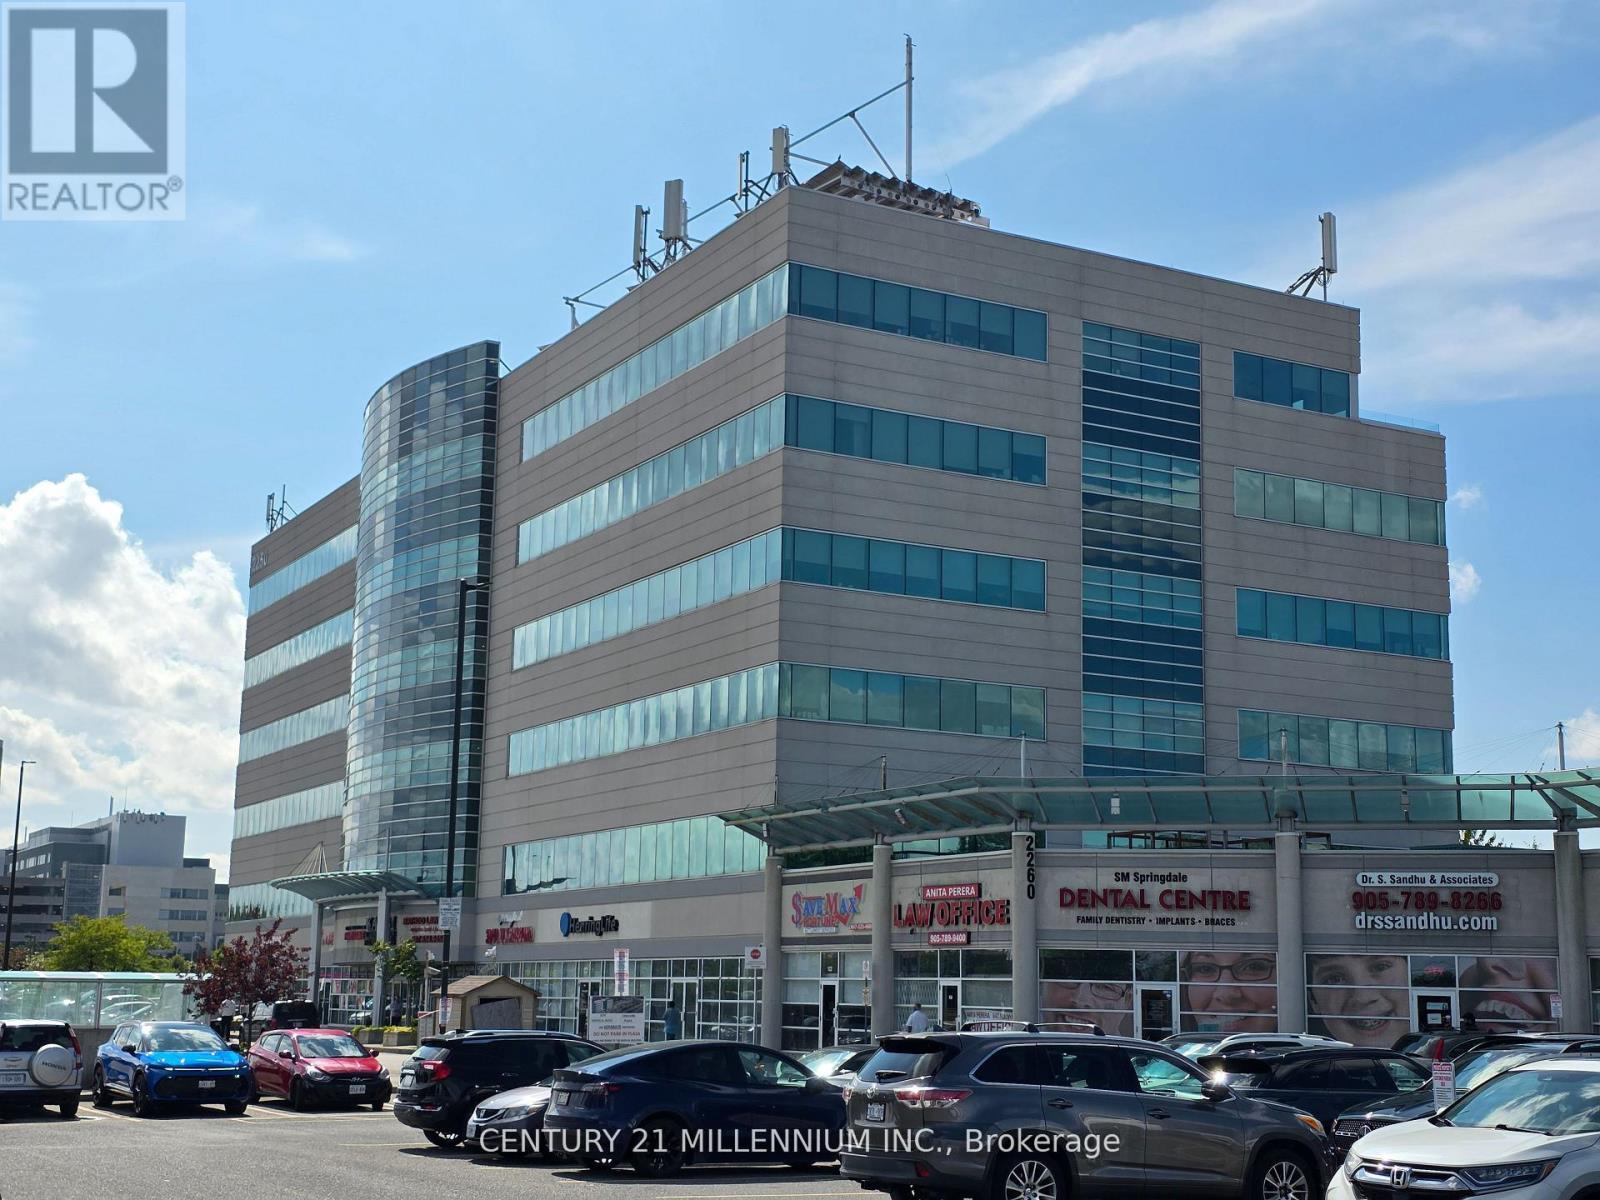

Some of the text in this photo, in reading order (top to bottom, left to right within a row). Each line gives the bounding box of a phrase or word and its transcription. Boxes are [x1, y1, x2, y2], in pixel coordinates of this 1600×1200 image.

[1026, 835, 1036, 900] 2260
[1114, 872, 1188, 884] SM Springdale
[1361, 874, 1494, 885] Dr. S. Sandhu & Associates
[925, 886, 976, 898] ANITA PERERA
[1059, 887, 1252, 911] DENTAL CENTRE
[1352, 891, 1503, 911] 905-789-8266
[893, 898, 1008, 928] LAW OFFICE
[1076, 916, 1236, 926] FAMILY DENTISTRY IMPLANTS BRACES
[1355, 912, 1498, 930] drssandhu.com
[42, 1061, 67, 1071] HONDA
